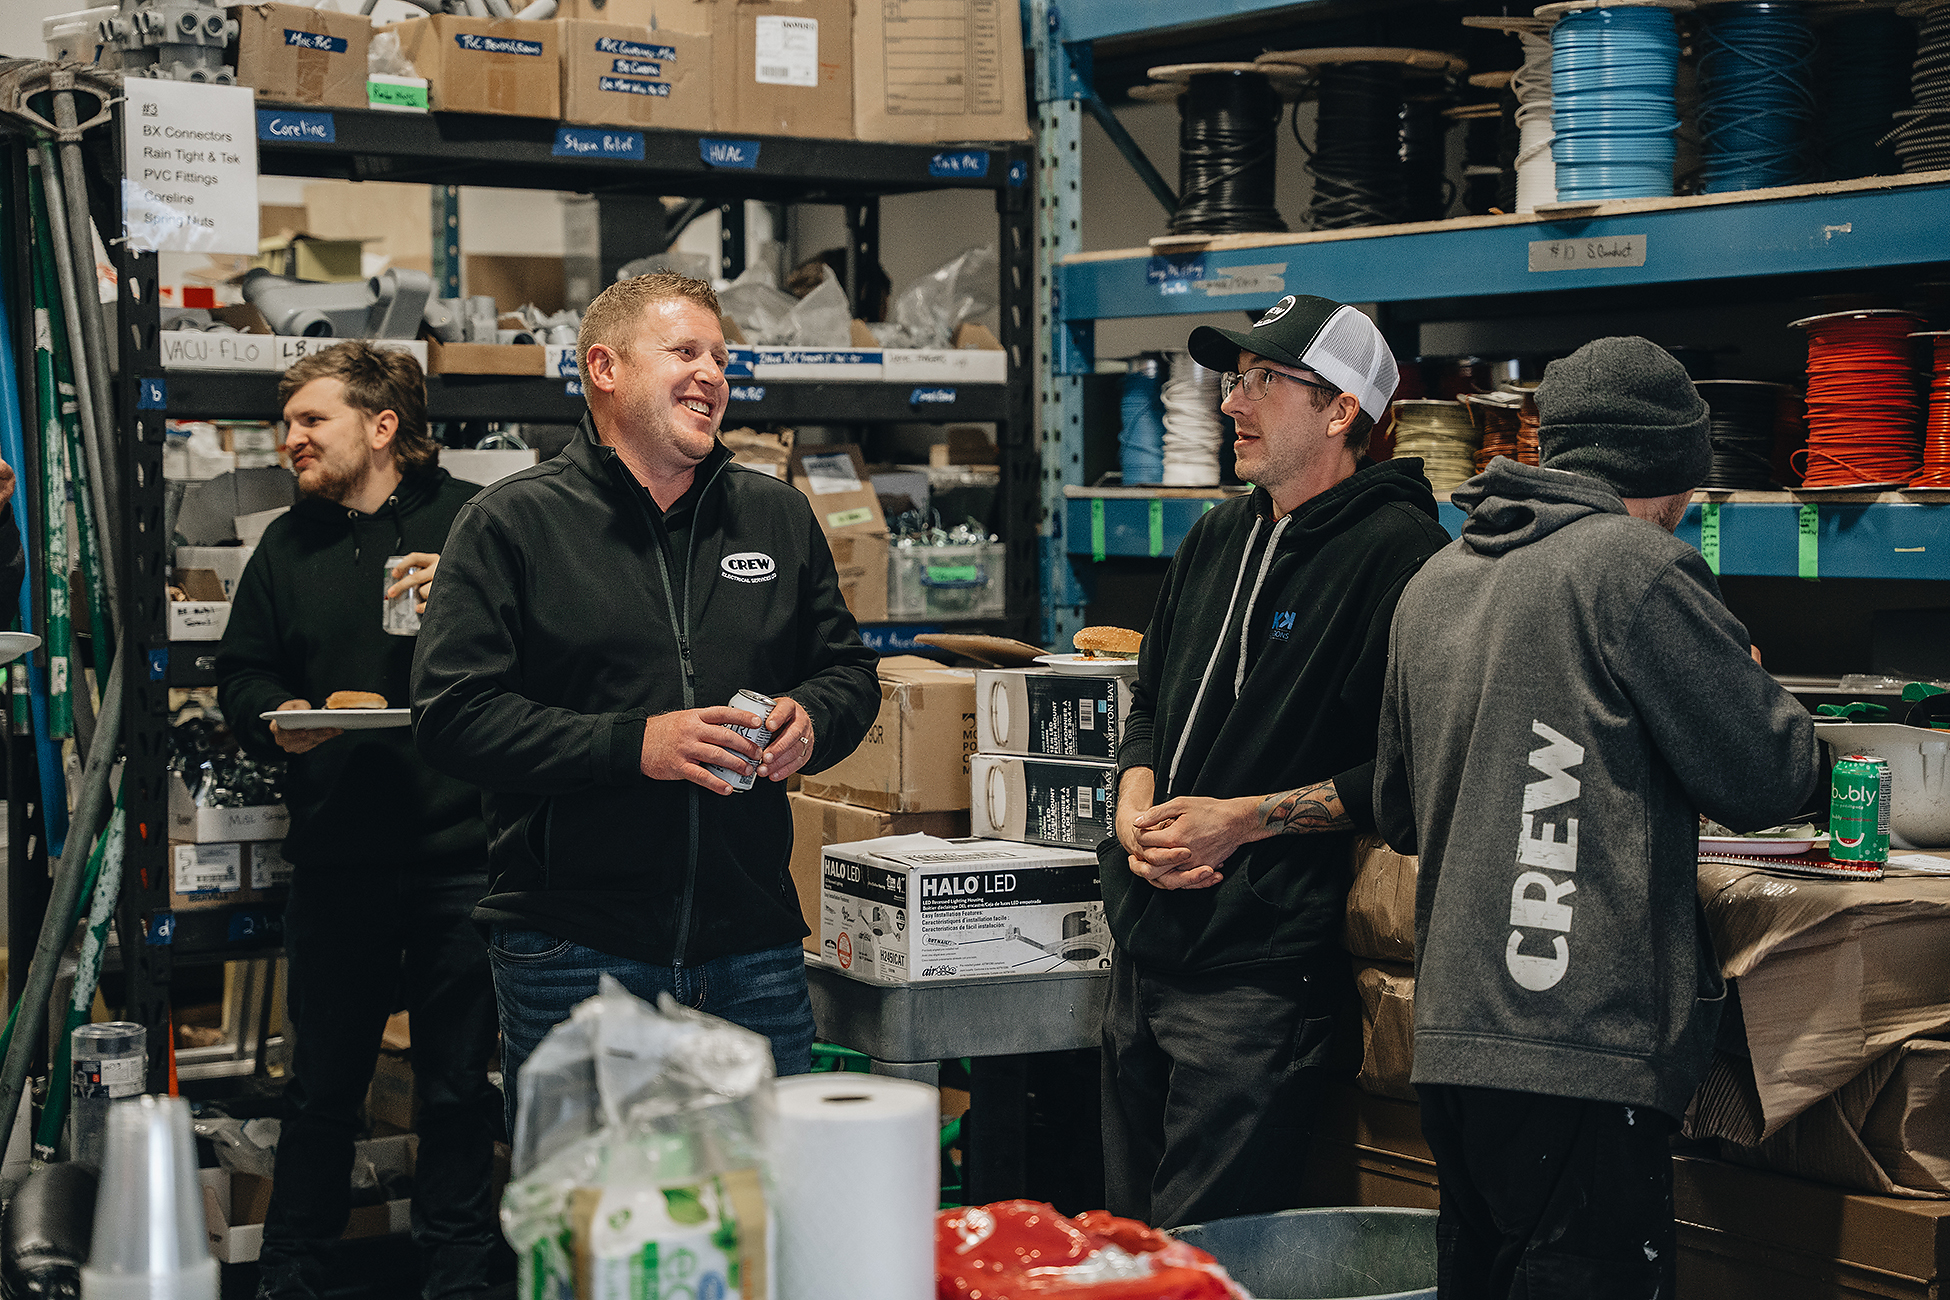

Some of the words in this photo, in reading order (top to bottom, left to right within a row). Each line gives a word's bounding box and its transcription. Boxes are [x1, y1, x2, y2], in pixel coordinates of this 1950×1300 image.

[141, 102, 158, 115] #3
[143, 125, 161, 137] BX
[165, 126, 232, 142] Connectors
[269, 118, 327, 138] Coreline
[144, 147, 171, 159] Rain
[176, 149, 204, 163] Tight
[207, 151, 216, 163] &
[220, 152, 241, 164] Tek
[709, 145, 744, 163] HVAC
[144, 168, 172, 181] PVC
[176, 171, 218, 186] Fittings
[144, 190, 194, 204] Coreline
[144, 212, 183, 227] Spring
[188, 215, 215, 227] Nuts
[219, 339, 260, 362] FLO
[151, 384, 162, 402] b
[728, 559, 770, 570] CREW
[721, 571, 751, 583] ELECTRICAL
[1832, 782, 1876, 807] bubly
[1506, 719, 1585, 991] CREW
[825, 859, 845, 879] HALO
[847, 864, 860, 883] LED
[984, 874, 1017, 893] LED
